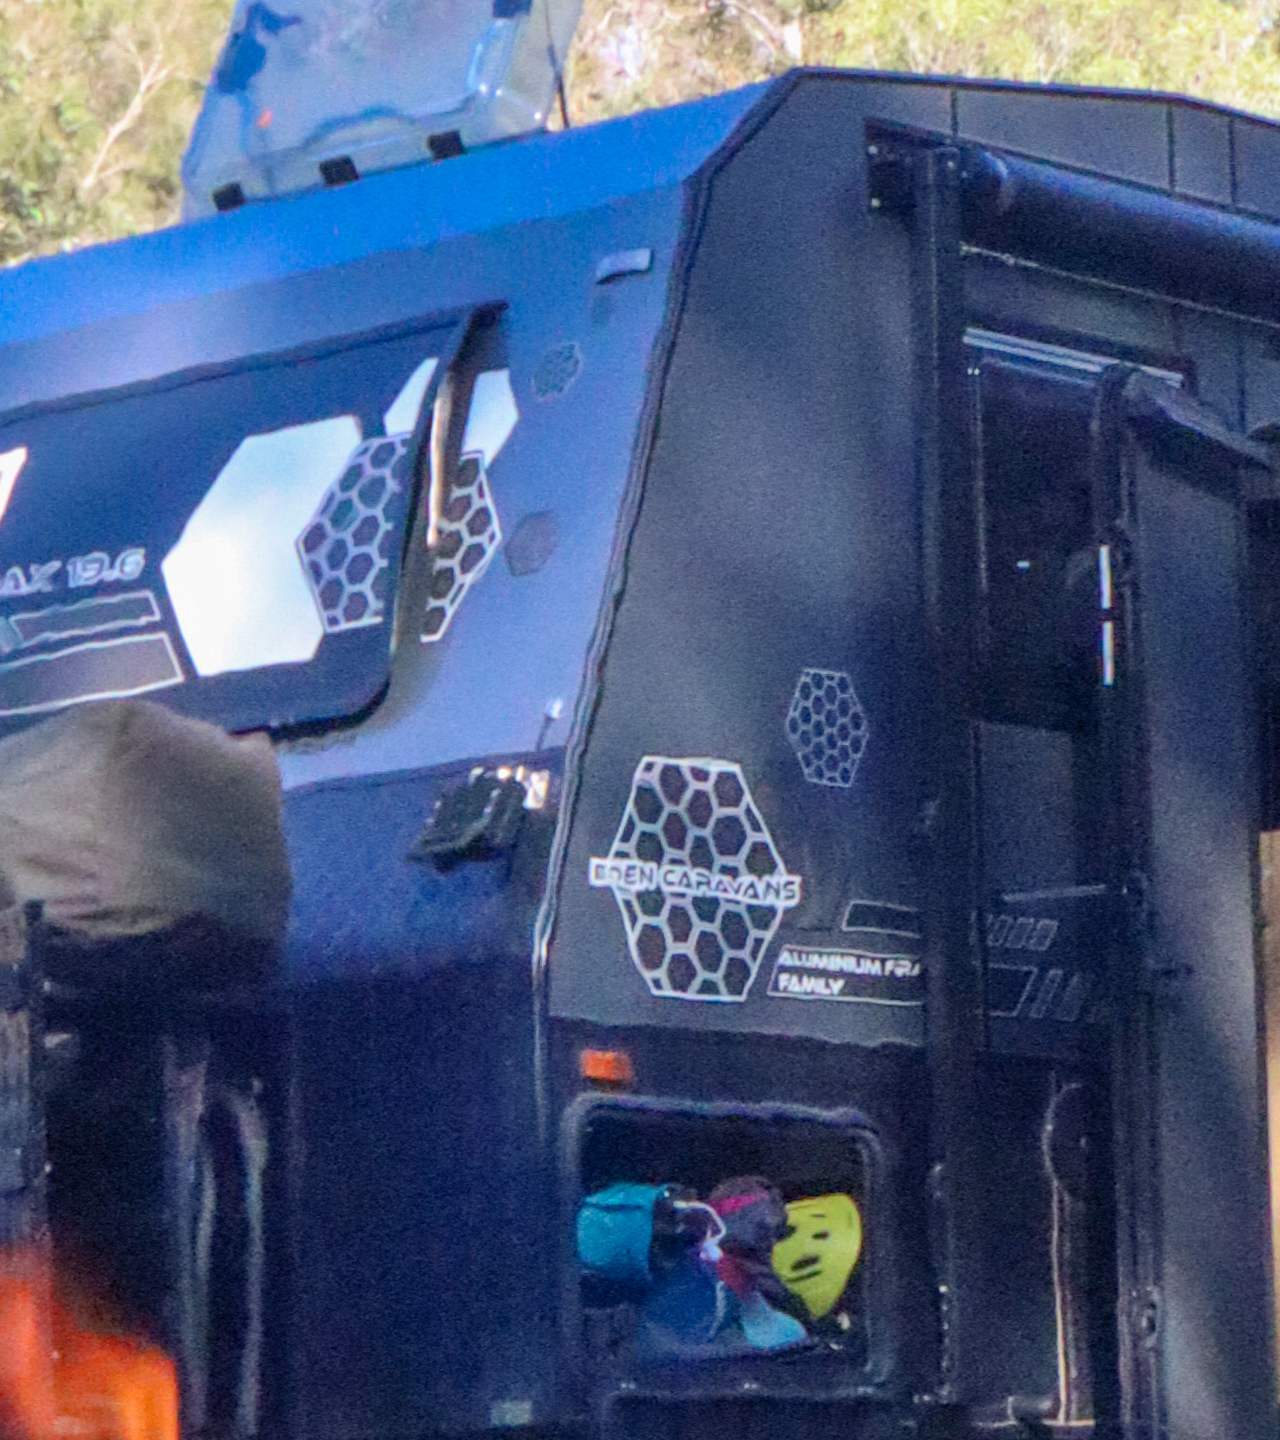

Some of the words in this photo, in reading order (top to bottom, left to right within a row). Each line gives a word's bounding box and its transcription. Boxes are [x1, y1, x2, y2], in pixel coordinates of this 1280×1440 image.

[591, 861, 656, 889] EDEN
[661, 866, 800, 905] CARAVANS
[777, 971, 845, 996] FAMILY
